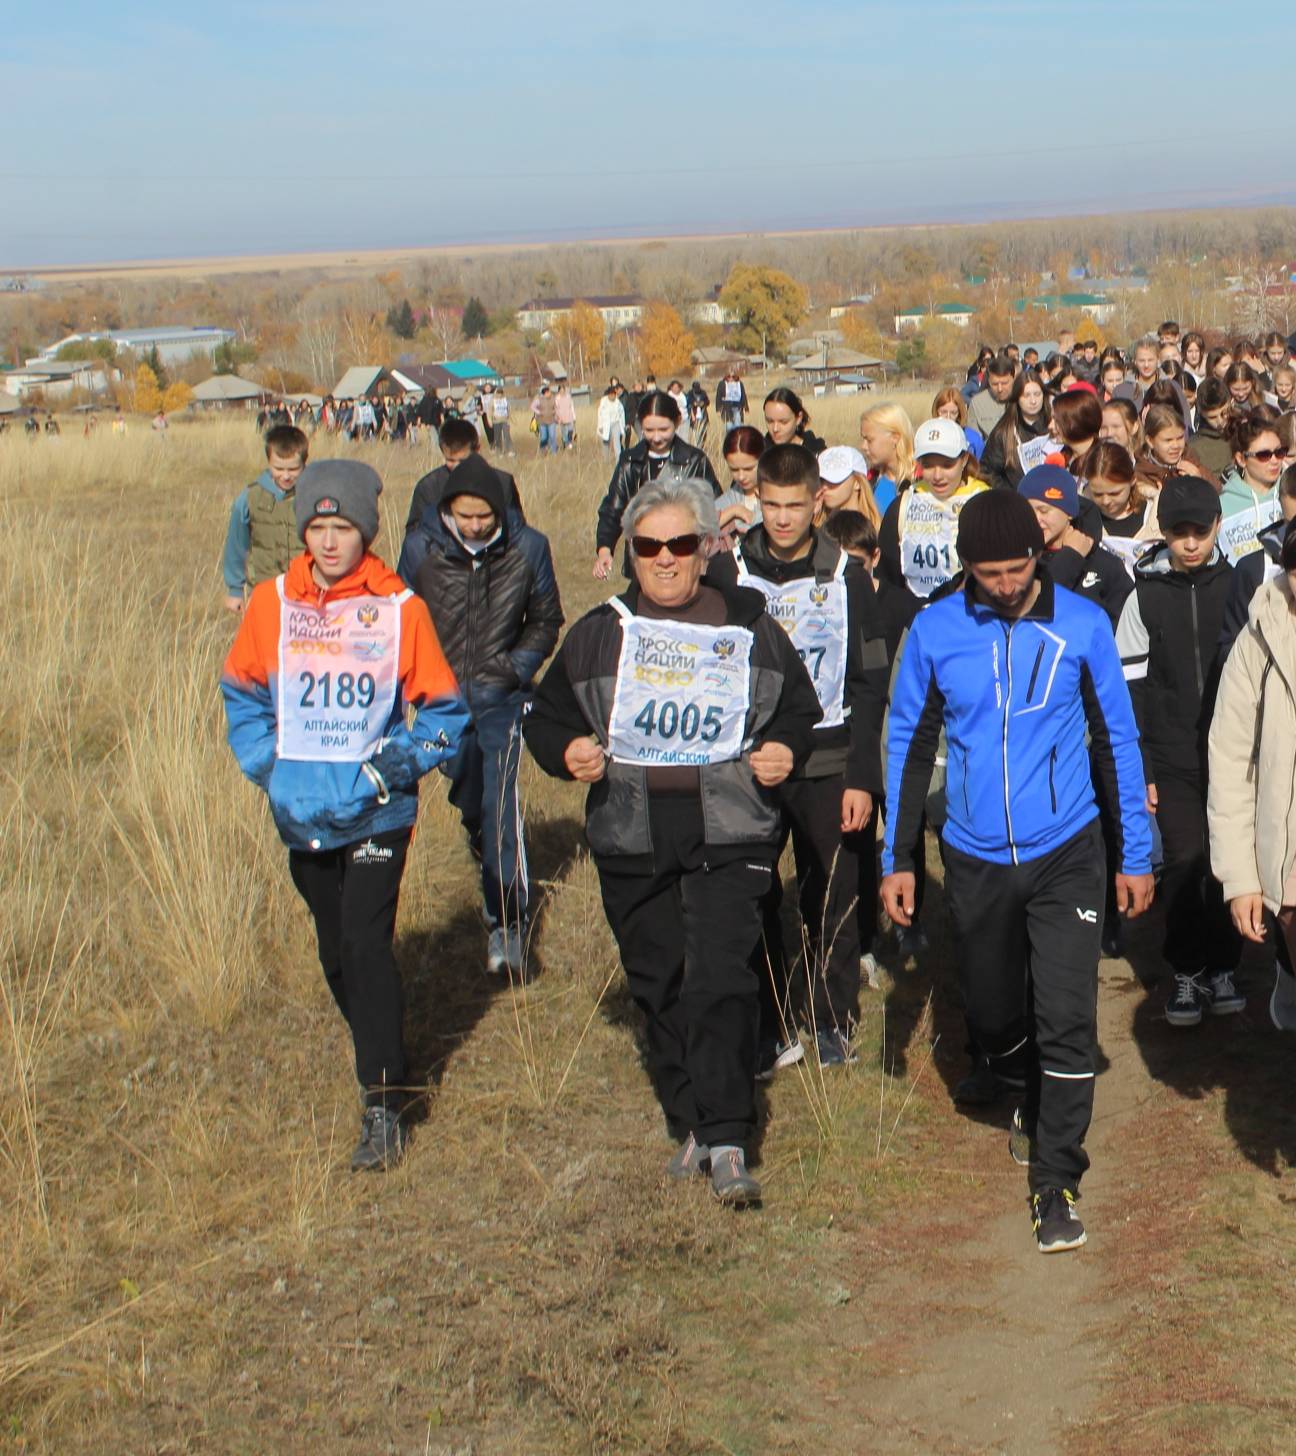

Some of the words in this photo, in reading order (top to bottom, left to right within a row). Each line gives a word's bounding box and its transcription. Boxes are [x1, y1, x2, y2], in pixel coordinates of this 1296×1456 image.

[290, 611, 331, 628] КРОСС
[289, 625, 342, 640] НАЦИИ
[290, 640, 342, 656] 2020
[638, 635, 682, 653] КРОСС
[634, 651, 696, 669] НАЦИИ
[300, 671, 376, 709] 2189
[304, 719, 368, 732] АЛТАЙСКИЙ
[634, 699, 724, 742] 4005
[321, 736, 349, 747] КРАЙ
[637, 747, 711, 764] АЛТАЙСКИЙ
